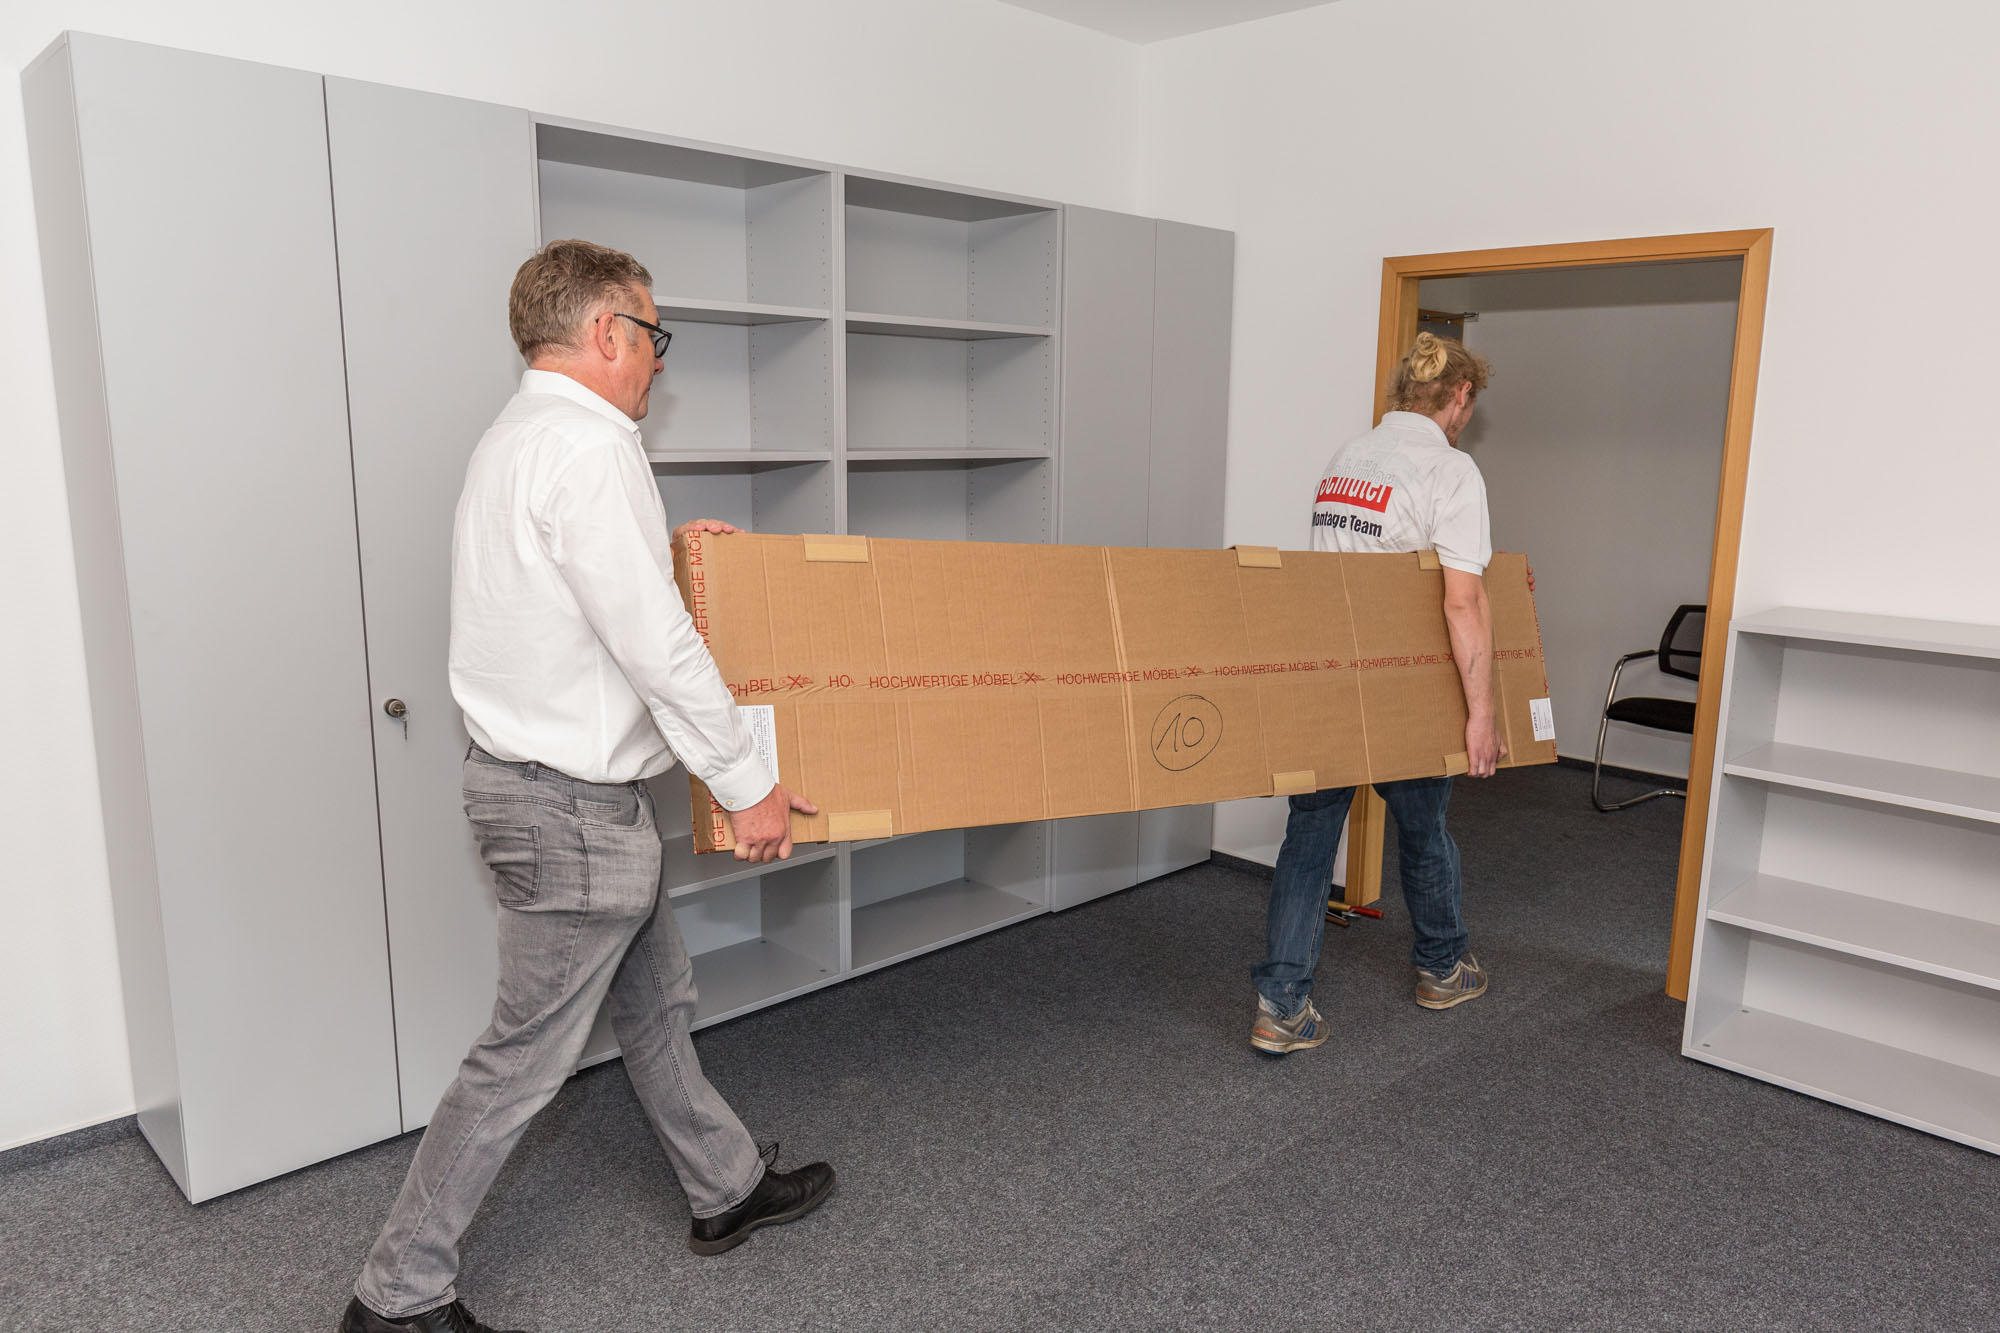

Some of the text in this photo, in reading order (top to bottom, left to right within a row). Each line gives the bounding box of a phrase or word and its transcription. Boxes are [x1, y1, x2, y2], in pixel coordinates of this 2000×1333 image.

[1350, 514, 1383, 538] Team
[1056, 666, 1181, 685] HOCHWERTIGE MÖBEL
[1215, 663, 1286, 677] HOCHWERTIGE
[869, 671, 1016, 689] HOCHWERTIGE MÖBEL
[1156, 712, 1205, 752] 10
